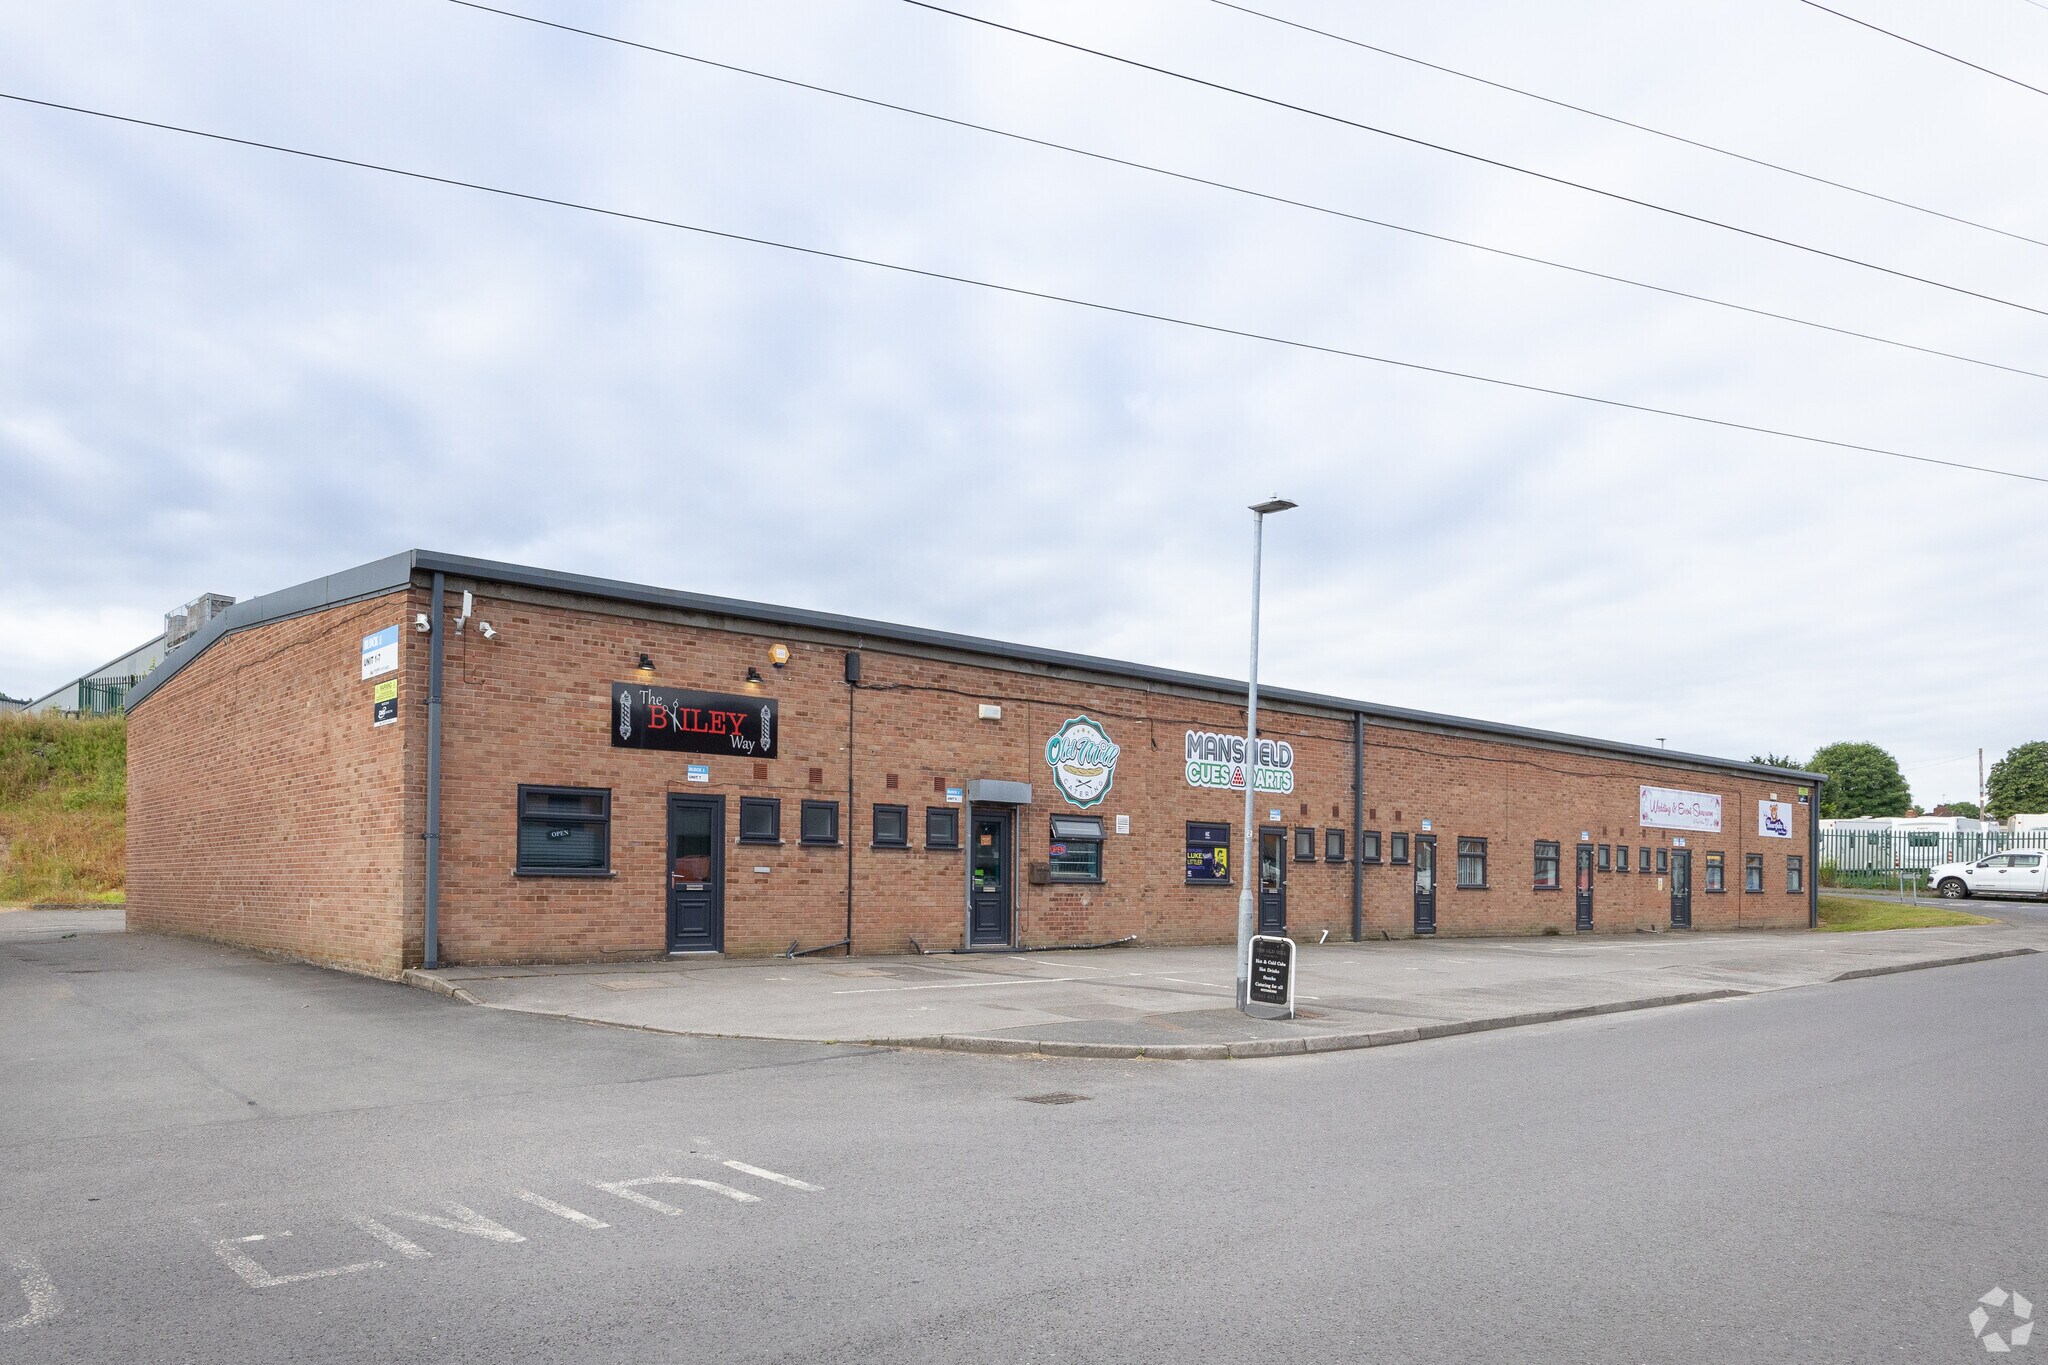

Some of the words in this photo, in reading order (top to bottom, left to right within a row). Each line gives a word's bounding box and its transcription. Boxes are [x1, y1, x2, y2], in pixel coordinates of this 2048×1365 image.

[364, 635, 378, 650] BLOCK
[364, 656, 374, 666] UNIT
[639, 689, 662, 705] The
[730, 734, 756, 754] Way
[1047, 737, 1077, 765] Old
[1076, 737, 1119, 767] Mill
[1187, 761, 1230, 785] CUES
[1246, 767, 1292, 791] ARTS
[1063, 778, 1104, 797] CATERING
[1650, 799, 1671, 816] Wedding
[1672, 801, 1677, 813] &
[1678, 802, 1692, 815] Event
